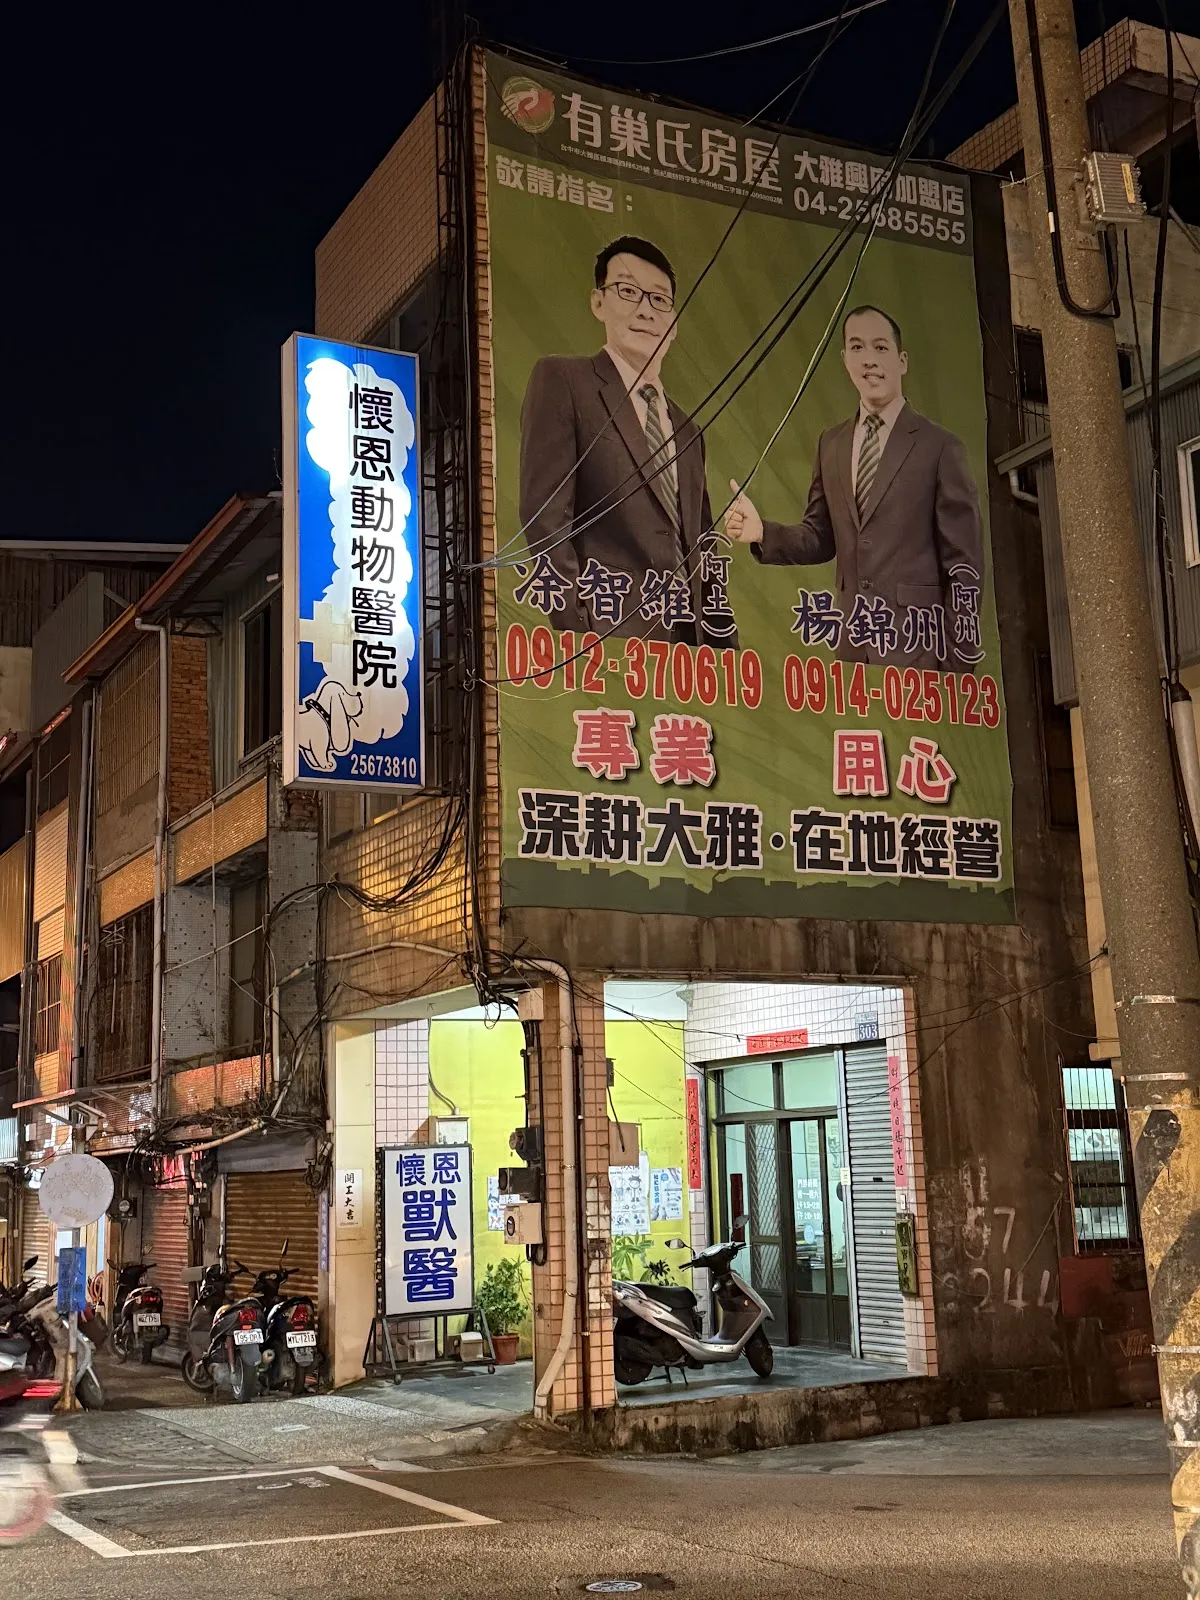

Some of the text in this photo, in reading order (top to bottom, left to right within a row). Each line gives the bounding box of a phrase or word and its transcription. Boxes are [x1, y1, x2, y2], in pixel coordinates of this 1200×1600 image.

[561, 92, 782, 192] 有巢氏房屋
[793, 187, 966, 245] 04-25685555
[349, 382, 397, 690] 懷恩動物醫院
[790, 588, 947, 661] 楊錦州
[506, 623, 762, 709] 0912-370619
[783, 654, 1000, 729] 0914-025123
[350, 753, 417, 779] 25673810
[572, 707, 957, 803] 專業 用心
[860, 1023, 878, 1040] 303
[344, 1172, 355, 1221] 開工大吉
[395, 1151, 462, 1187] 懷恩
[402, 1187, 458, 1303] 獸醫
